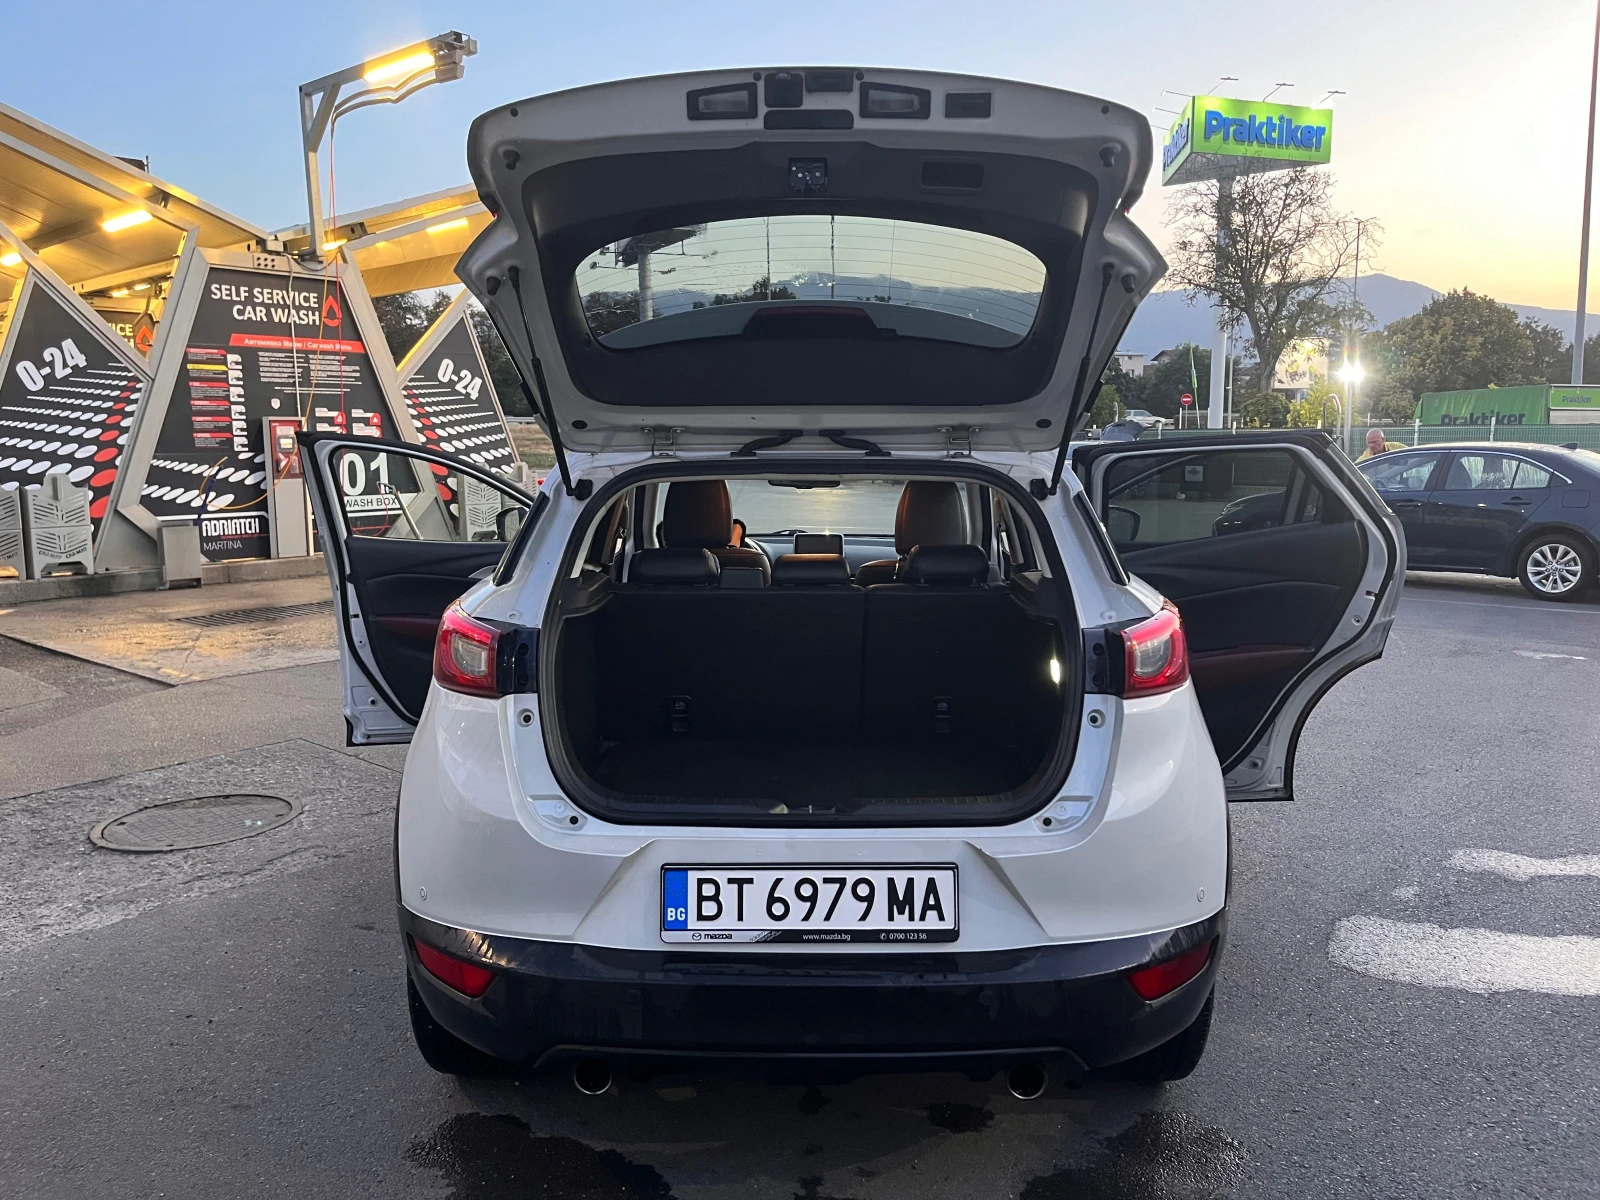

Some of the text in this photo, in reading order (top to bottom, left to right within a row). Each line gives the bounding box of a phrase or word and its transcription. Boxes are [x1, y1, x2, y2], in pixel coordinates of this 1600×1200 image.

[1204, 109, 1326, 152] Praktiker
[210, 283, 319, 308] SELF SERVICE
[232, 304, 320, 326] CAR WASH
[15, 338, 88, 392] 0-24
[437, 358, 483, 401] 0-24
[339, 452, 389, 496] 01
[376, 497, 397, 507] BOX
[203, 540, 243, 551] MARTINA
[696, 877, 946, 922] BT 6979 MA
[667, 907, 686, 921] BG
[802, 933, 851, 941] www.mazda.bg
[889, 932, 927, 940] 0700 123 56
